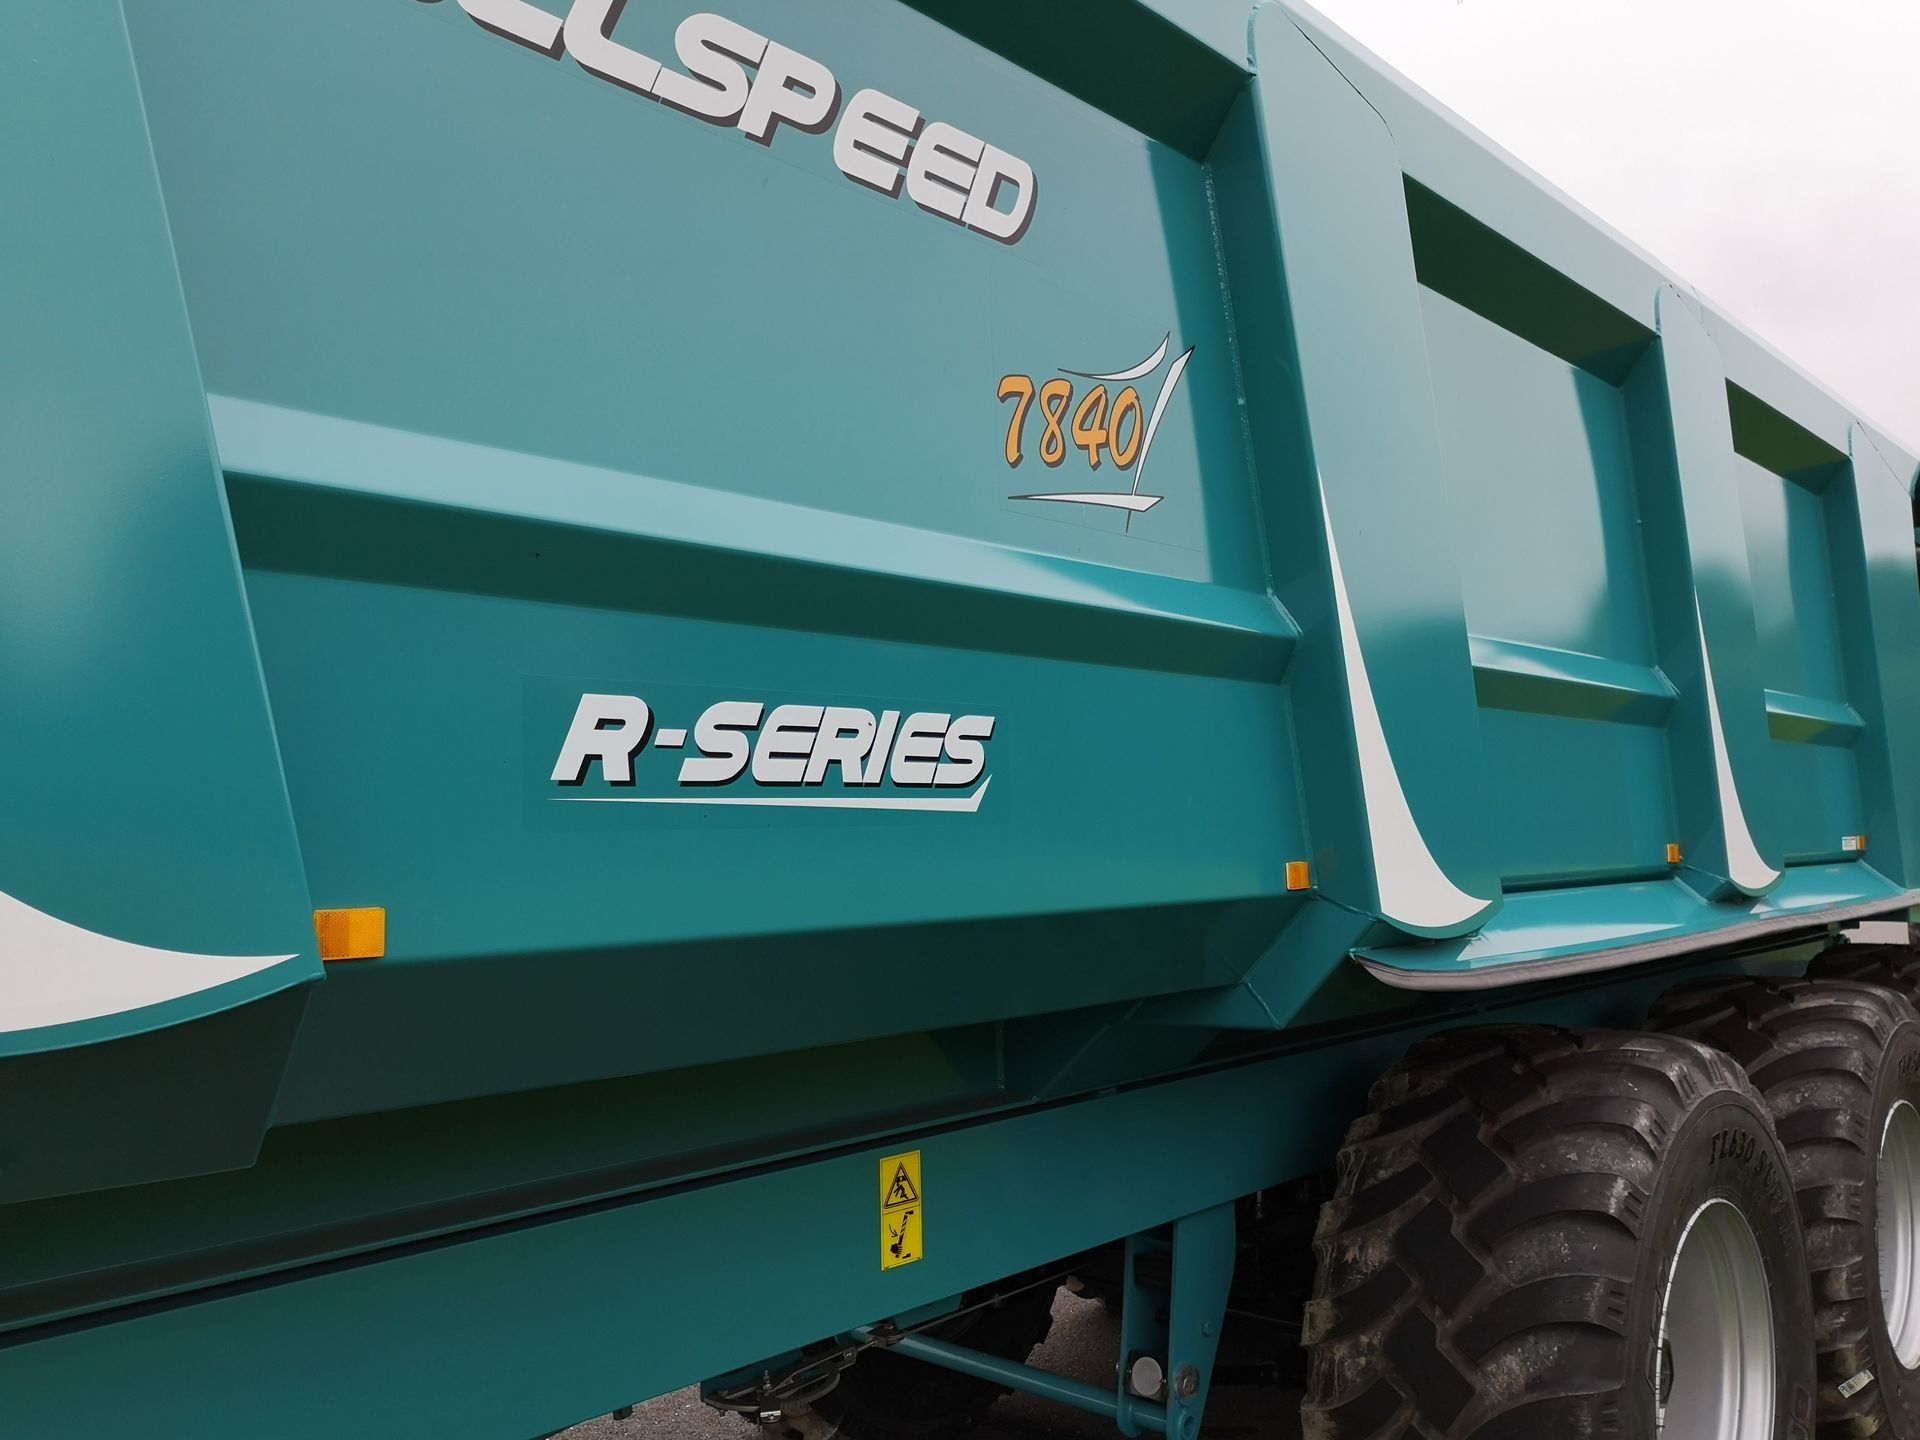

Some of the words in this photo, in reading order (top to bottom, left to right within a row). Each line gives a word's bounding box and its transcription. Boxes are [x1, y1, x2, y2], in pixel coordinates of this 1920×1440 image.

[416, 0, 1037, 245] LSPEED
[997, 374, 1144, 472] 7840
[550, 693, 995, 788] R-SERIES
